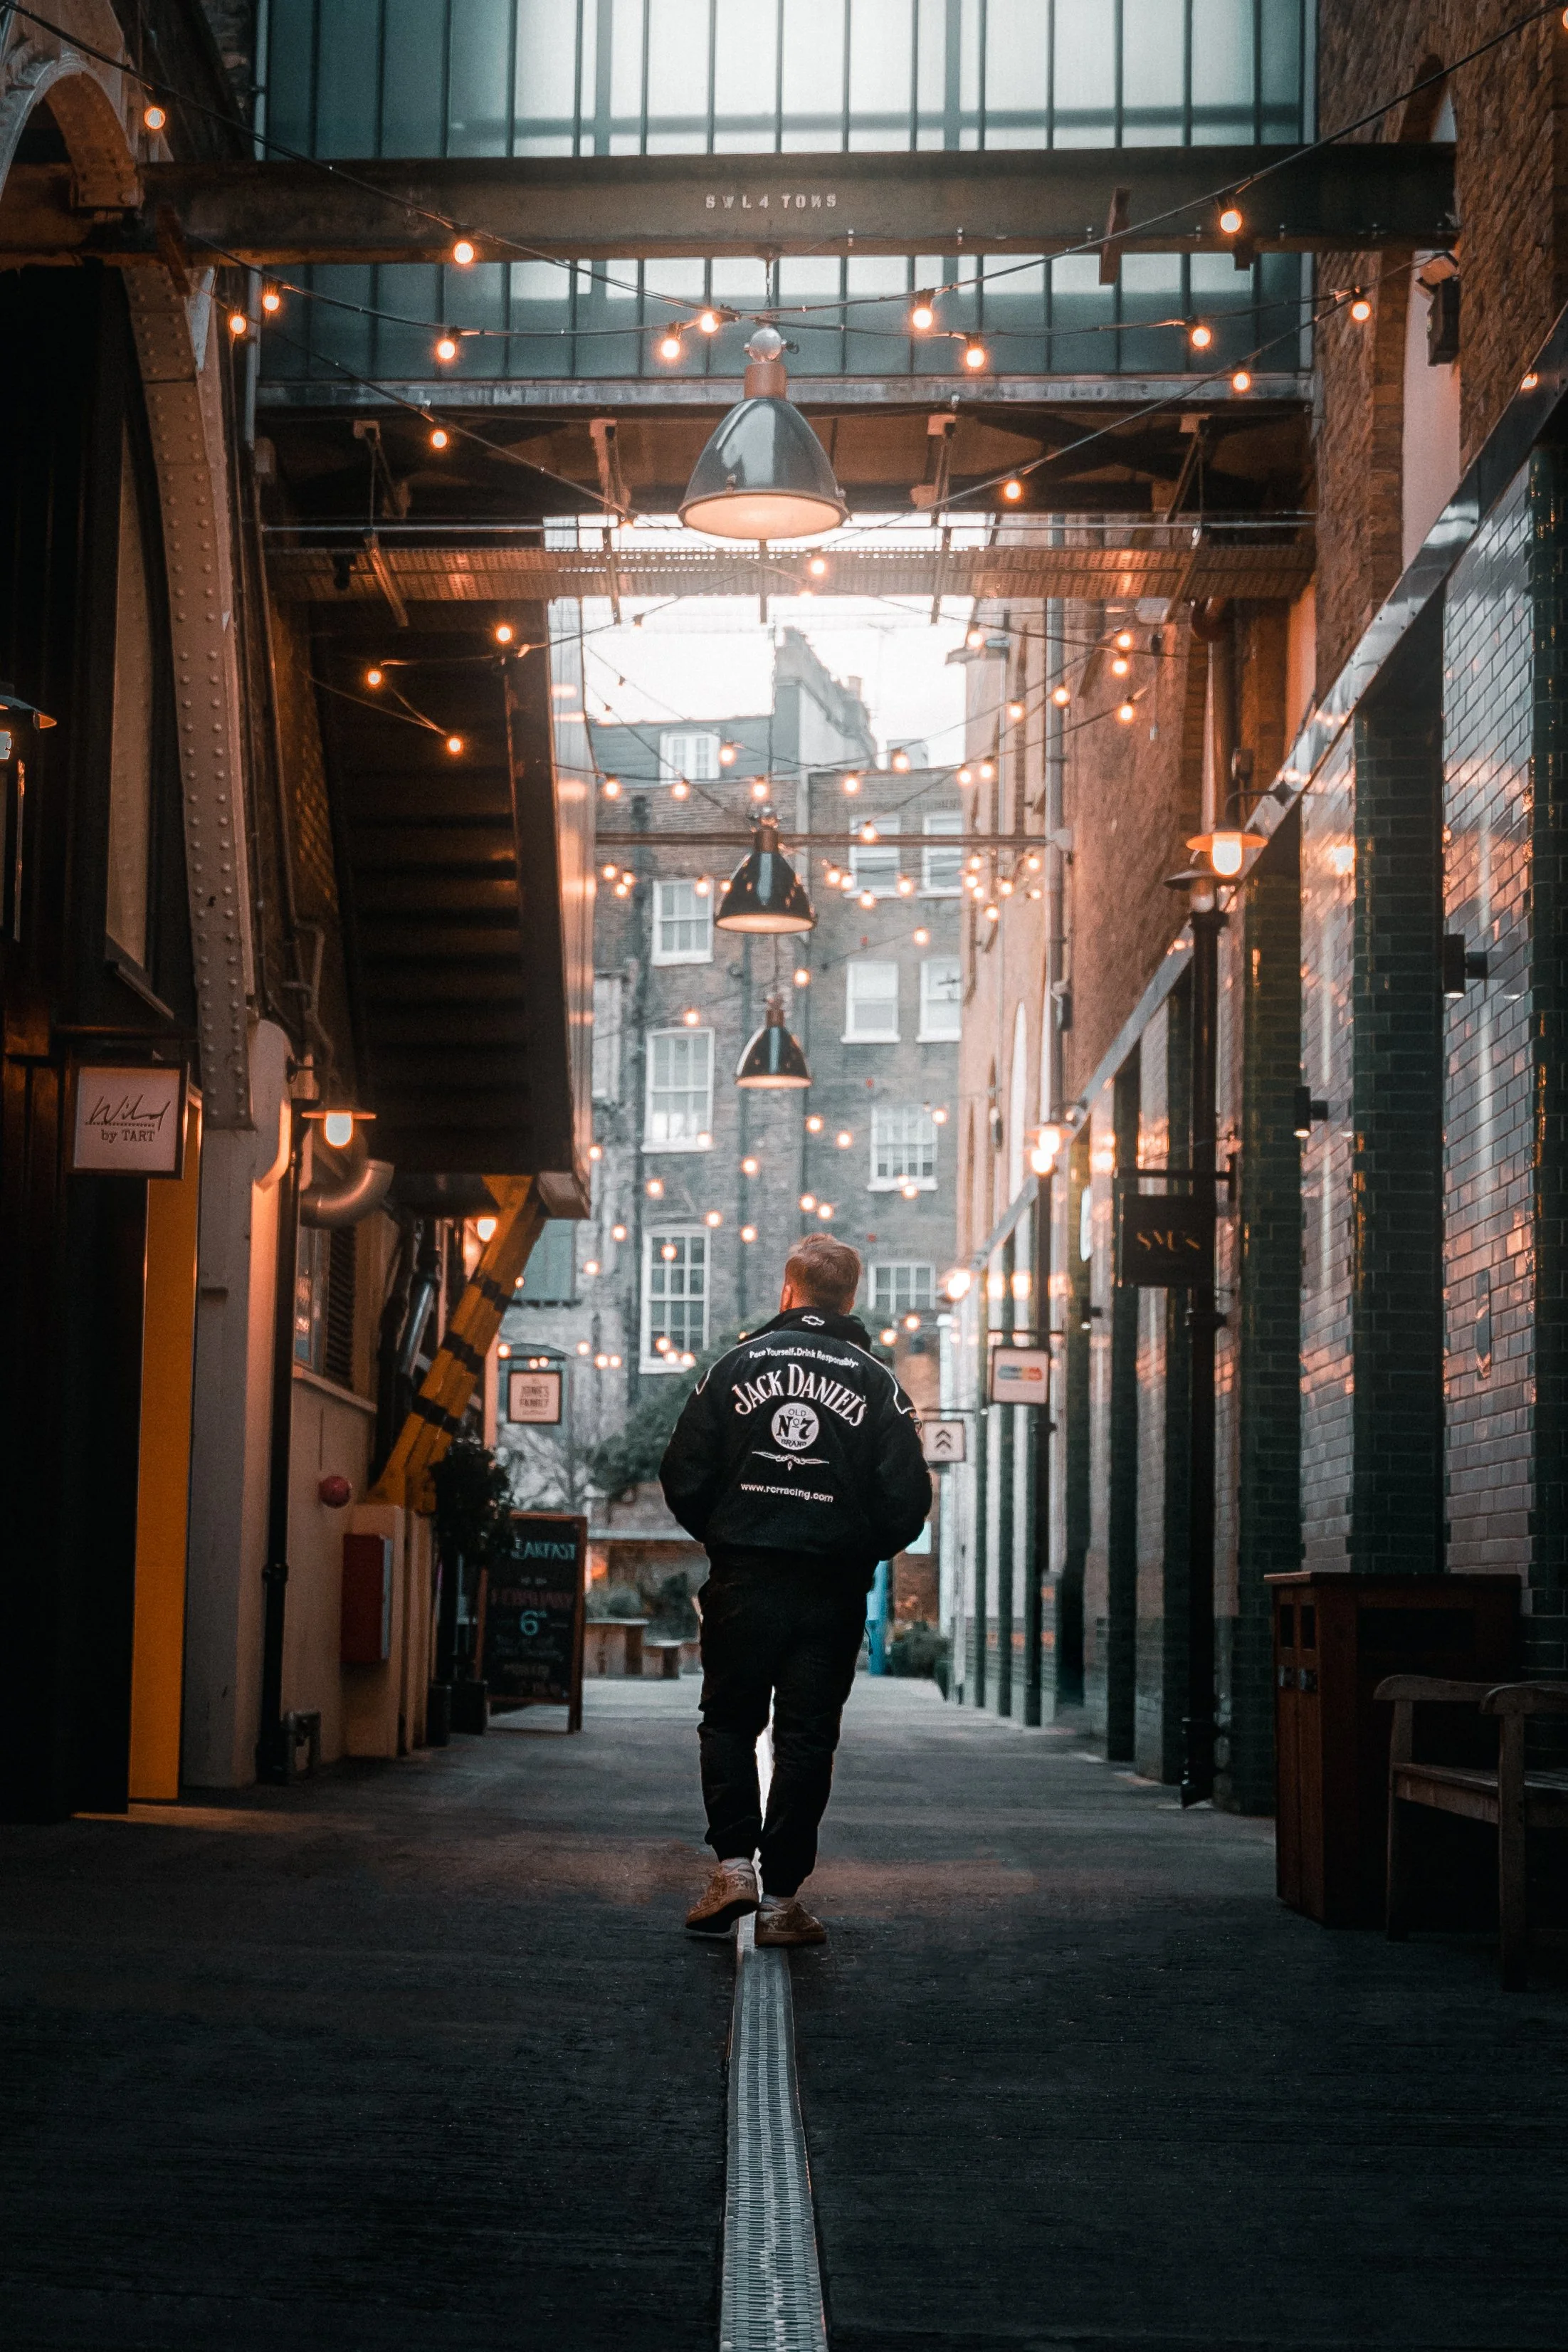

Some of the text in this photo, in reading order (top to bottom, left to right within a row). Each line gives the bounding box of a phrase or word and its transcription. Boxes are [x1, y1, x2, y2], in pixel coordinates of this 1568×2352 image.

[781, 193, 837, 209] TONS
[101, 1129, 155, 1143] by TART
[749, 1350, 766, 1359] Pace
[797, 1347, 816, 1358] Drink
[732, 1363, 868, 1427] JACK DANIEL'S
